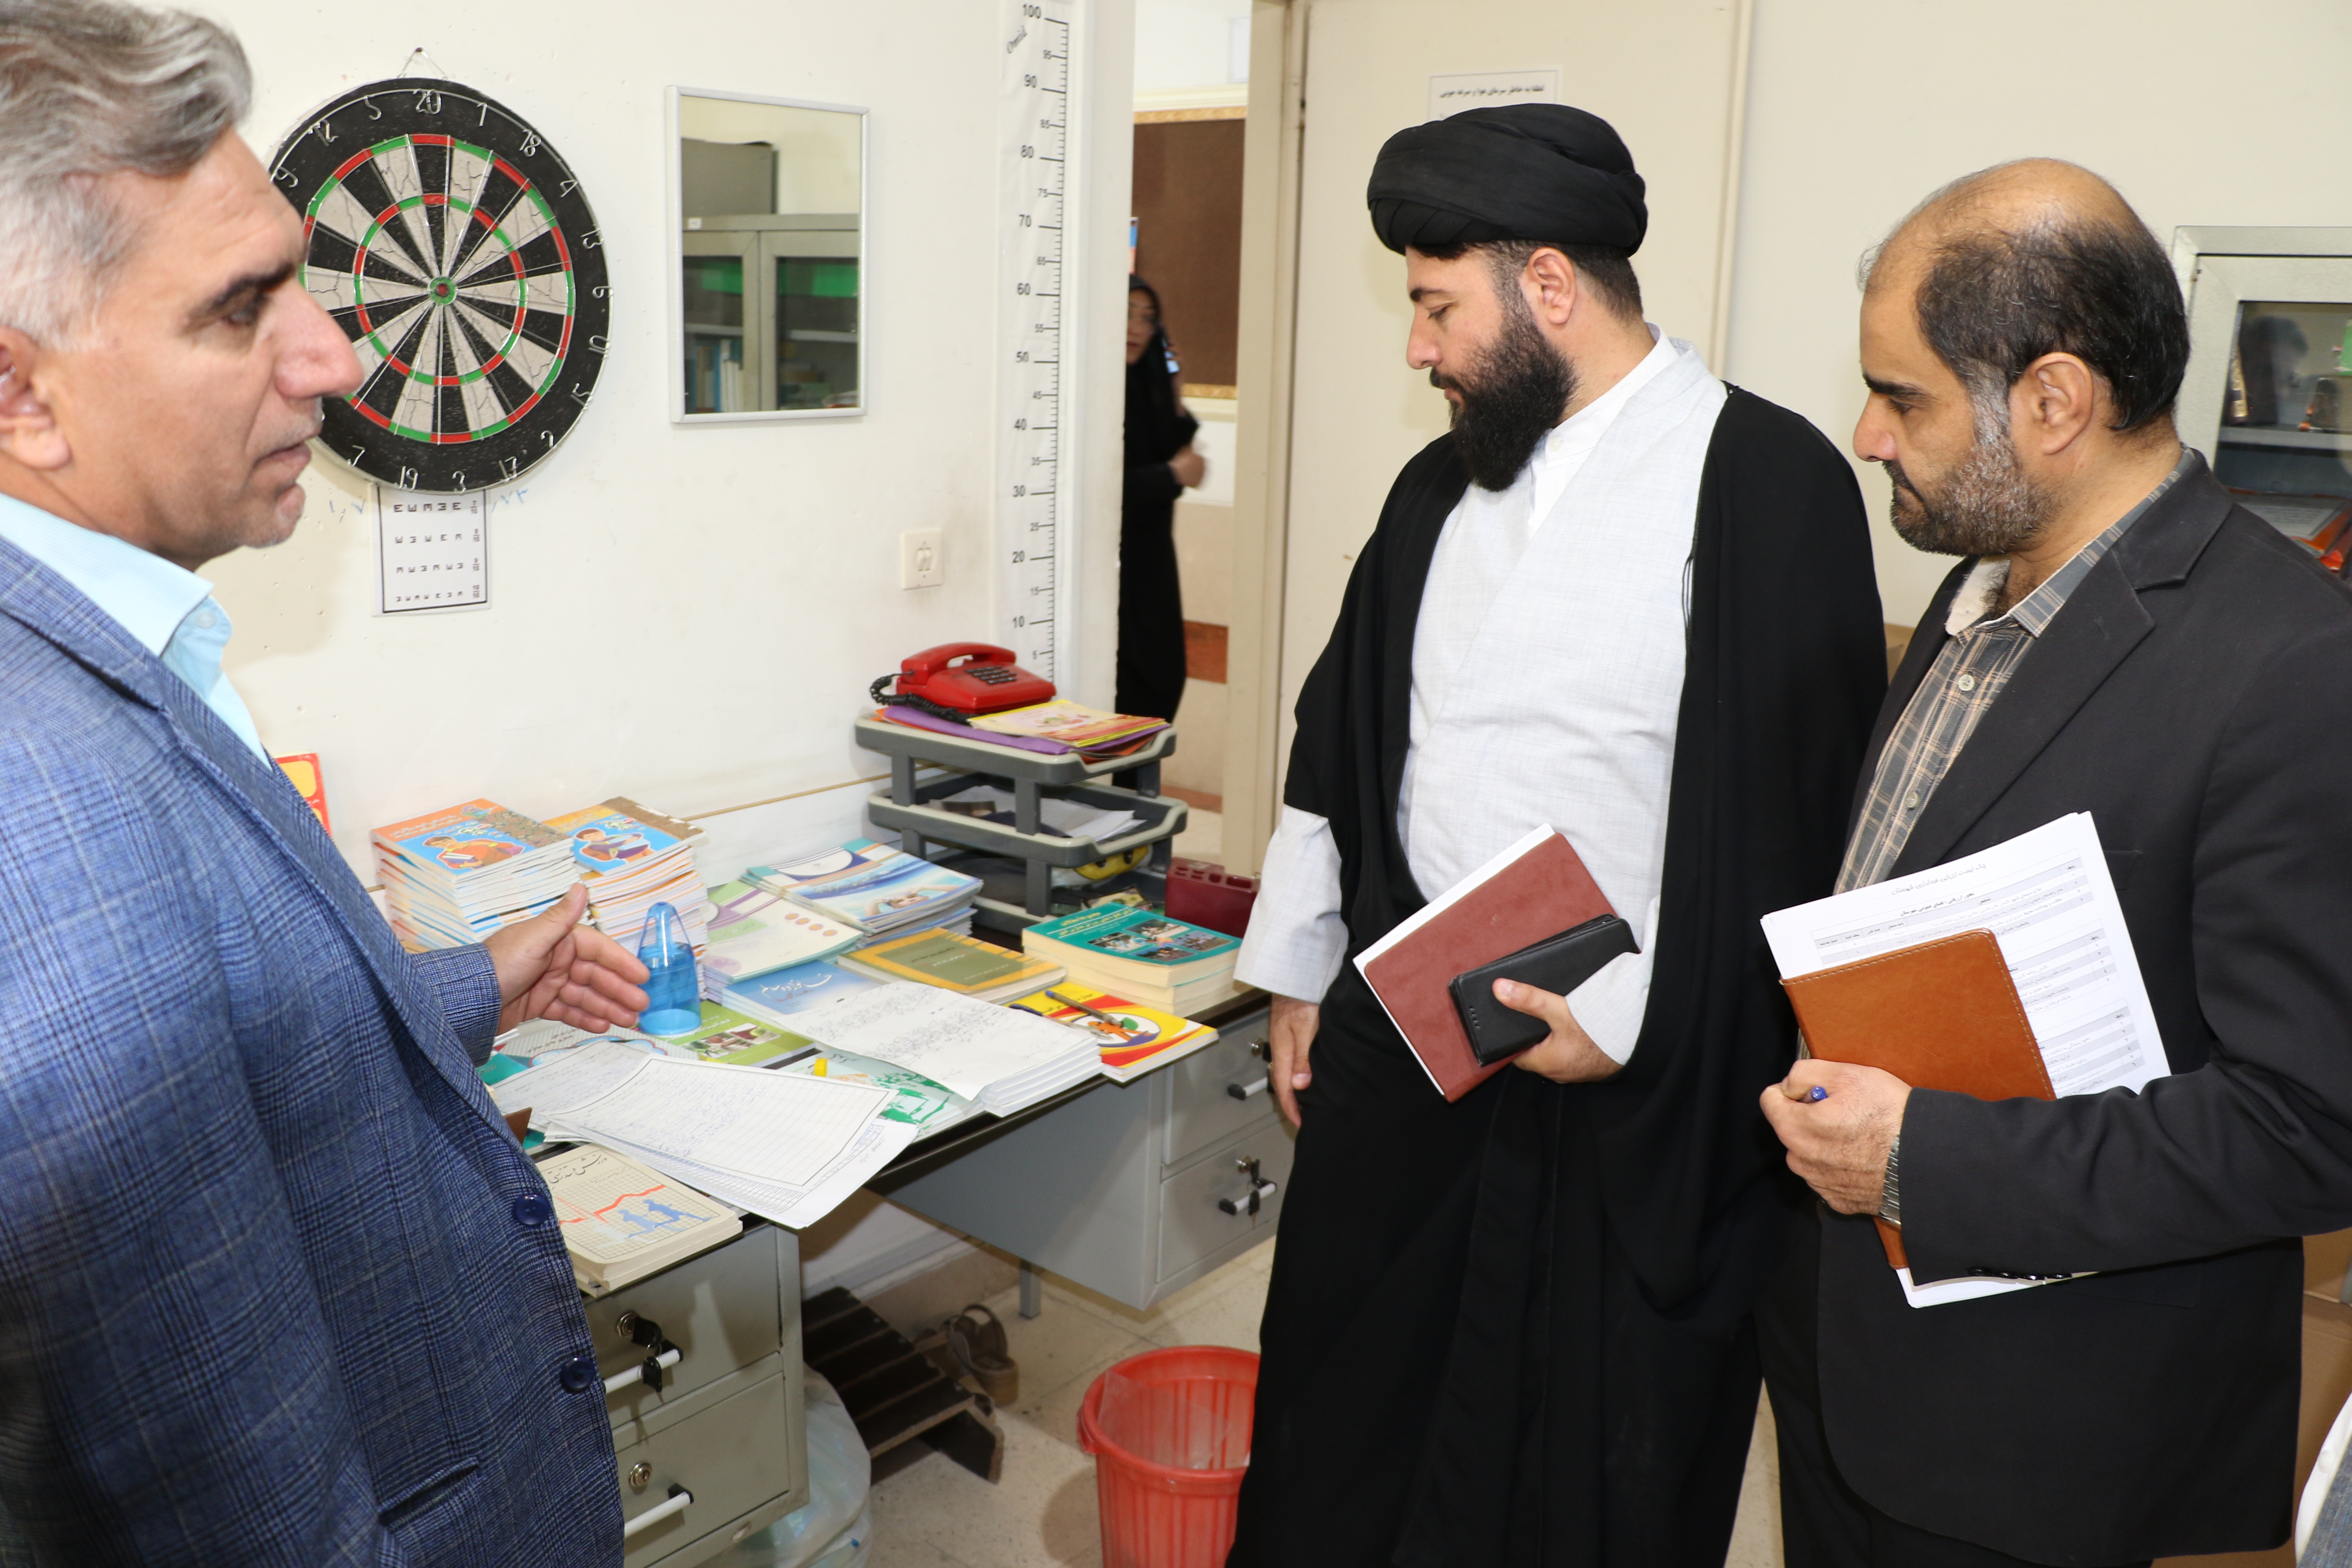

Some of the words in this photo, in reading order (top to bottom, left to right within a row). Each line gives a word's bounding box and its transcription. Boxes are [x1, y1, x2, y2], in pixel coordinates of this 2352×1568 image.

[1023, 3, 1041, 18] 100
[1043, 49, 1051, 59] 95
[1024, 74, 1037, 88] 90
[365, 96, 381, 120] 5
[413, 91, 441, 114] 20
[477, 103, 487, 126] 1
[1040, 119, 1050, 130] 85
[308, 120, 339, 146] 12
[520, 129, 541, 156] 18
[1021, 145, 1034, 159] 80
[276, 166, 298, 187] 9
[560, 180, 578, 197] 4
[1038, 189, 1048, 198] 75
[1019, 215, 1032, 228] 70
[581, 227, 603, 249] 13
[1037, 257, 1046, 266] 65
[592, 285, 613, 297] 6
[1017, 283, 1030, 296] 60
[1035, 324, 1044, 333] 55
[588, 337, 610, 357] 10
[1016, 352, 1029, 363] 50
[570, 383, 592, 410] 15
[1032, 391, 1042, 400] 45
[1014, 419, 1027, 430] 40
[541, 431, 554, 447] 2
[347, 446, 365, 467] 7
[1032, 457, 1041, 466] 35
[499, 458, 517, 478] 17
[400, 466, 418, 489] 19
[453, 471, 465, 493] 3
[1013, 486, 1025, 497] 30
[1030, 523, 1040, 531] 25
[1012, 551, 1025, 563] 20
[1030, 587, 1039, 595] 15
[1012, 616, 1024, 628] 10
